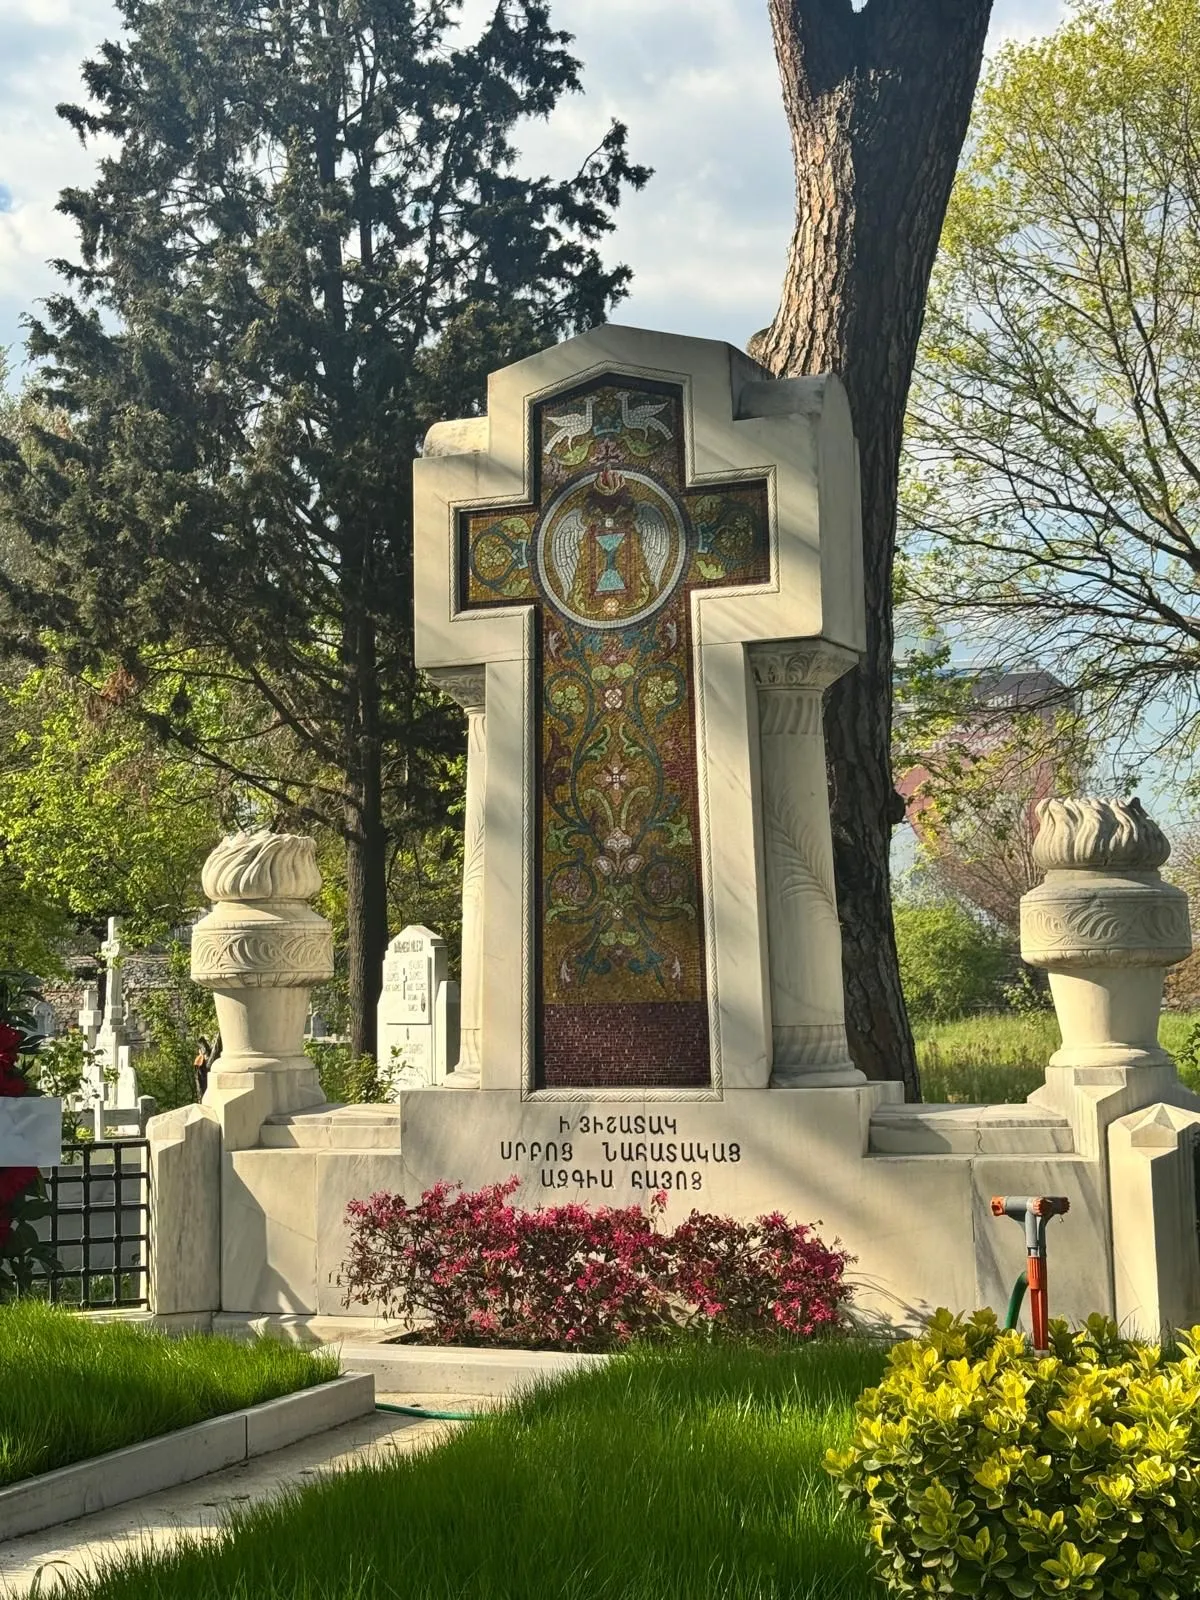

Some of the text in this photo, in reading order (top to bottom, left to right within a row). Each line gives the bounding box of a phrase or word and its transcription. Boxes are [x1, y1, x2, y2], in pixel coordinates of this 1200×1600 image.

[559, 1115, 678, 1135] Ի ՅԻՇԱՏԱԿ
[500, 1141, 741, 1163] ՍՐԲՈՑ ՆԱՀԱՏԱԿԱՑ
[540, 1169, 703, 1191] ԱԶԳԻՍ ՀԱՅՈՑ
